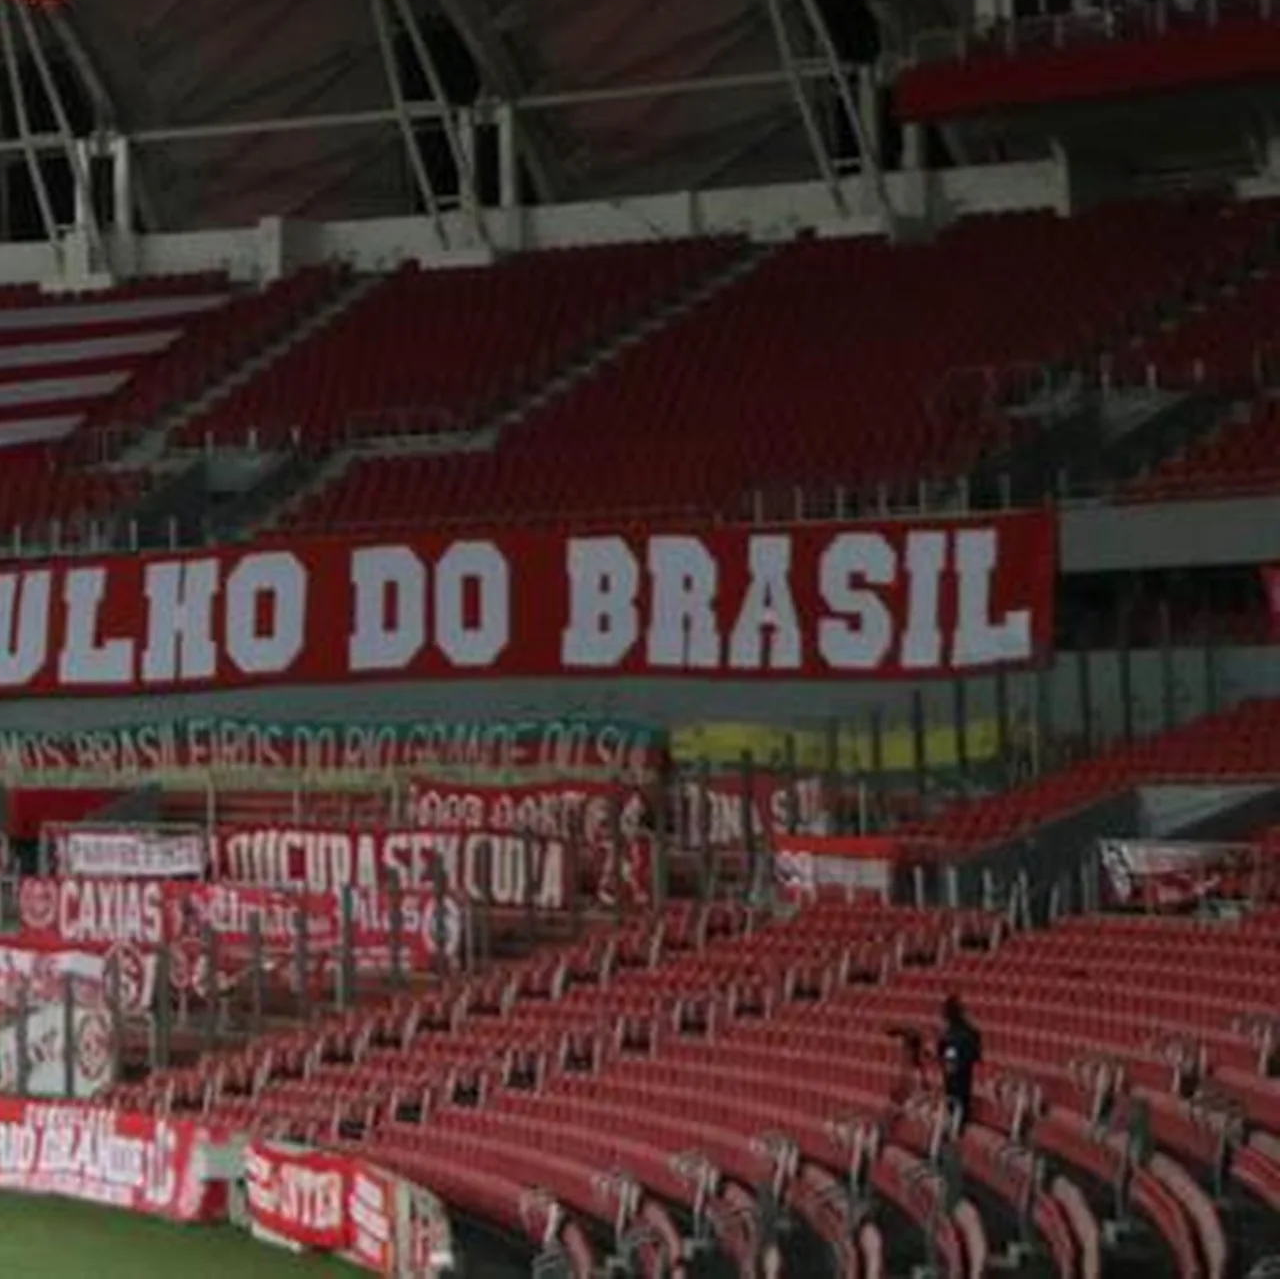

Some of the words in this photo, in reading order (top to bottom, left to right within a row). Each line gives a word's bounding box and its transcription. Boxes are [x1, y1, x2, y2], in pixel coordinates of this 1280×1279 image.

[349, 540, 510, 673] DO
[560, 529, 1032, 668] BRASIL
[59, 880, 162, 943] CAXIAS
